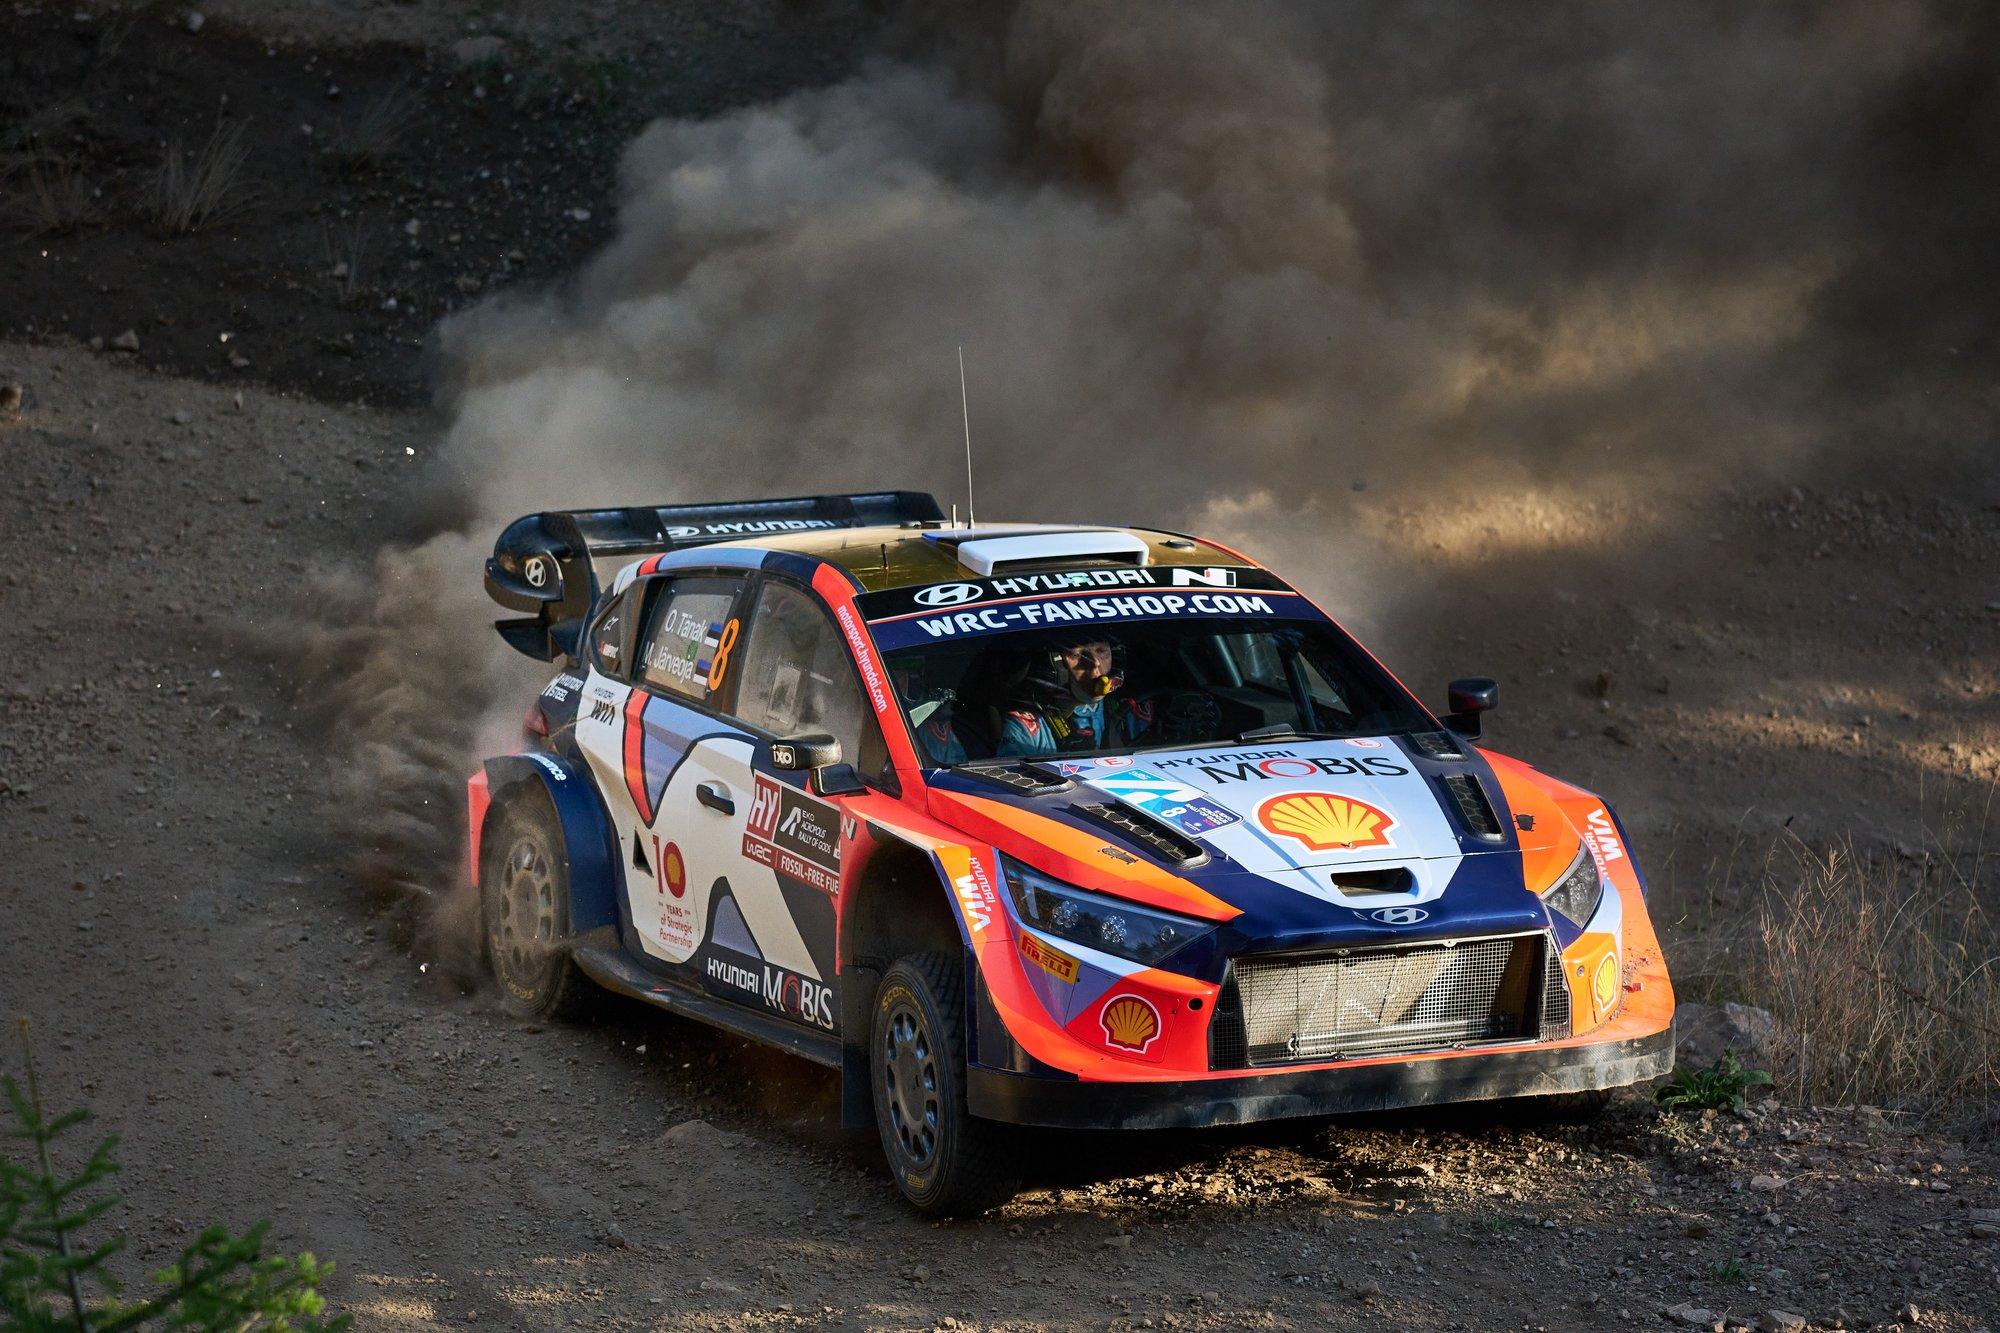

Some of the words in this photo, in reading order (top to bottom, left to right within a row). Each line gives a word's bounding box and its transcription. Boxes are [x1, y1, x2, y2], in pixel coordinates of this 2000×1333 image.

[706, 520, 836, 535] HYUNDAI
[991, 569, 1156, 595] HYUNDAI
[664, 609, 678, 632] O.
[677, 612, 707, 643] Tänak
[916, 594, 1275, 638] WRC-FANSHOP.COM
[653, 646, 694, 684] Järveoja
[708, 618, 740, 691] 8
[837, 604, 888, 713] motorsport.hyundai.com
[1152, 750, 1299, 769] HYUNDAI
[1197, 756, 1410, 785] MOBIS
[749, 783, 778, 832] HY
[801, 810, 815, 821] EKO
[1160, 806, 1187, 818] 8
[798, 831, 812, 846] RALLY
[811, 837, 820, 848] OF
[818, 840, 832, 853] GODS
[801, 820, 827, 837] ACROPOLIS
[1586, 808, 1624, 862] WIA
[652, 834, 686, 899] 10
[746, 840, 772, 863] WRC
[781, 855, 825, 888] FOSSIL-FREE
[967, 857, 996, 904] HYUNDAI
[666, 903, 683, 918] YEARS
[955, 874, 992, 933] WIA
[660, 914, 667, 925] of
[667, 916, 693, 936] Strategic
[660, 927, 693, 949] Partnership
[1021, 934, 1073, 978] PIRELLI
[706, 957, 760, 994] HYUNDAI
[763, 965, 834, 1030] MOBIS
